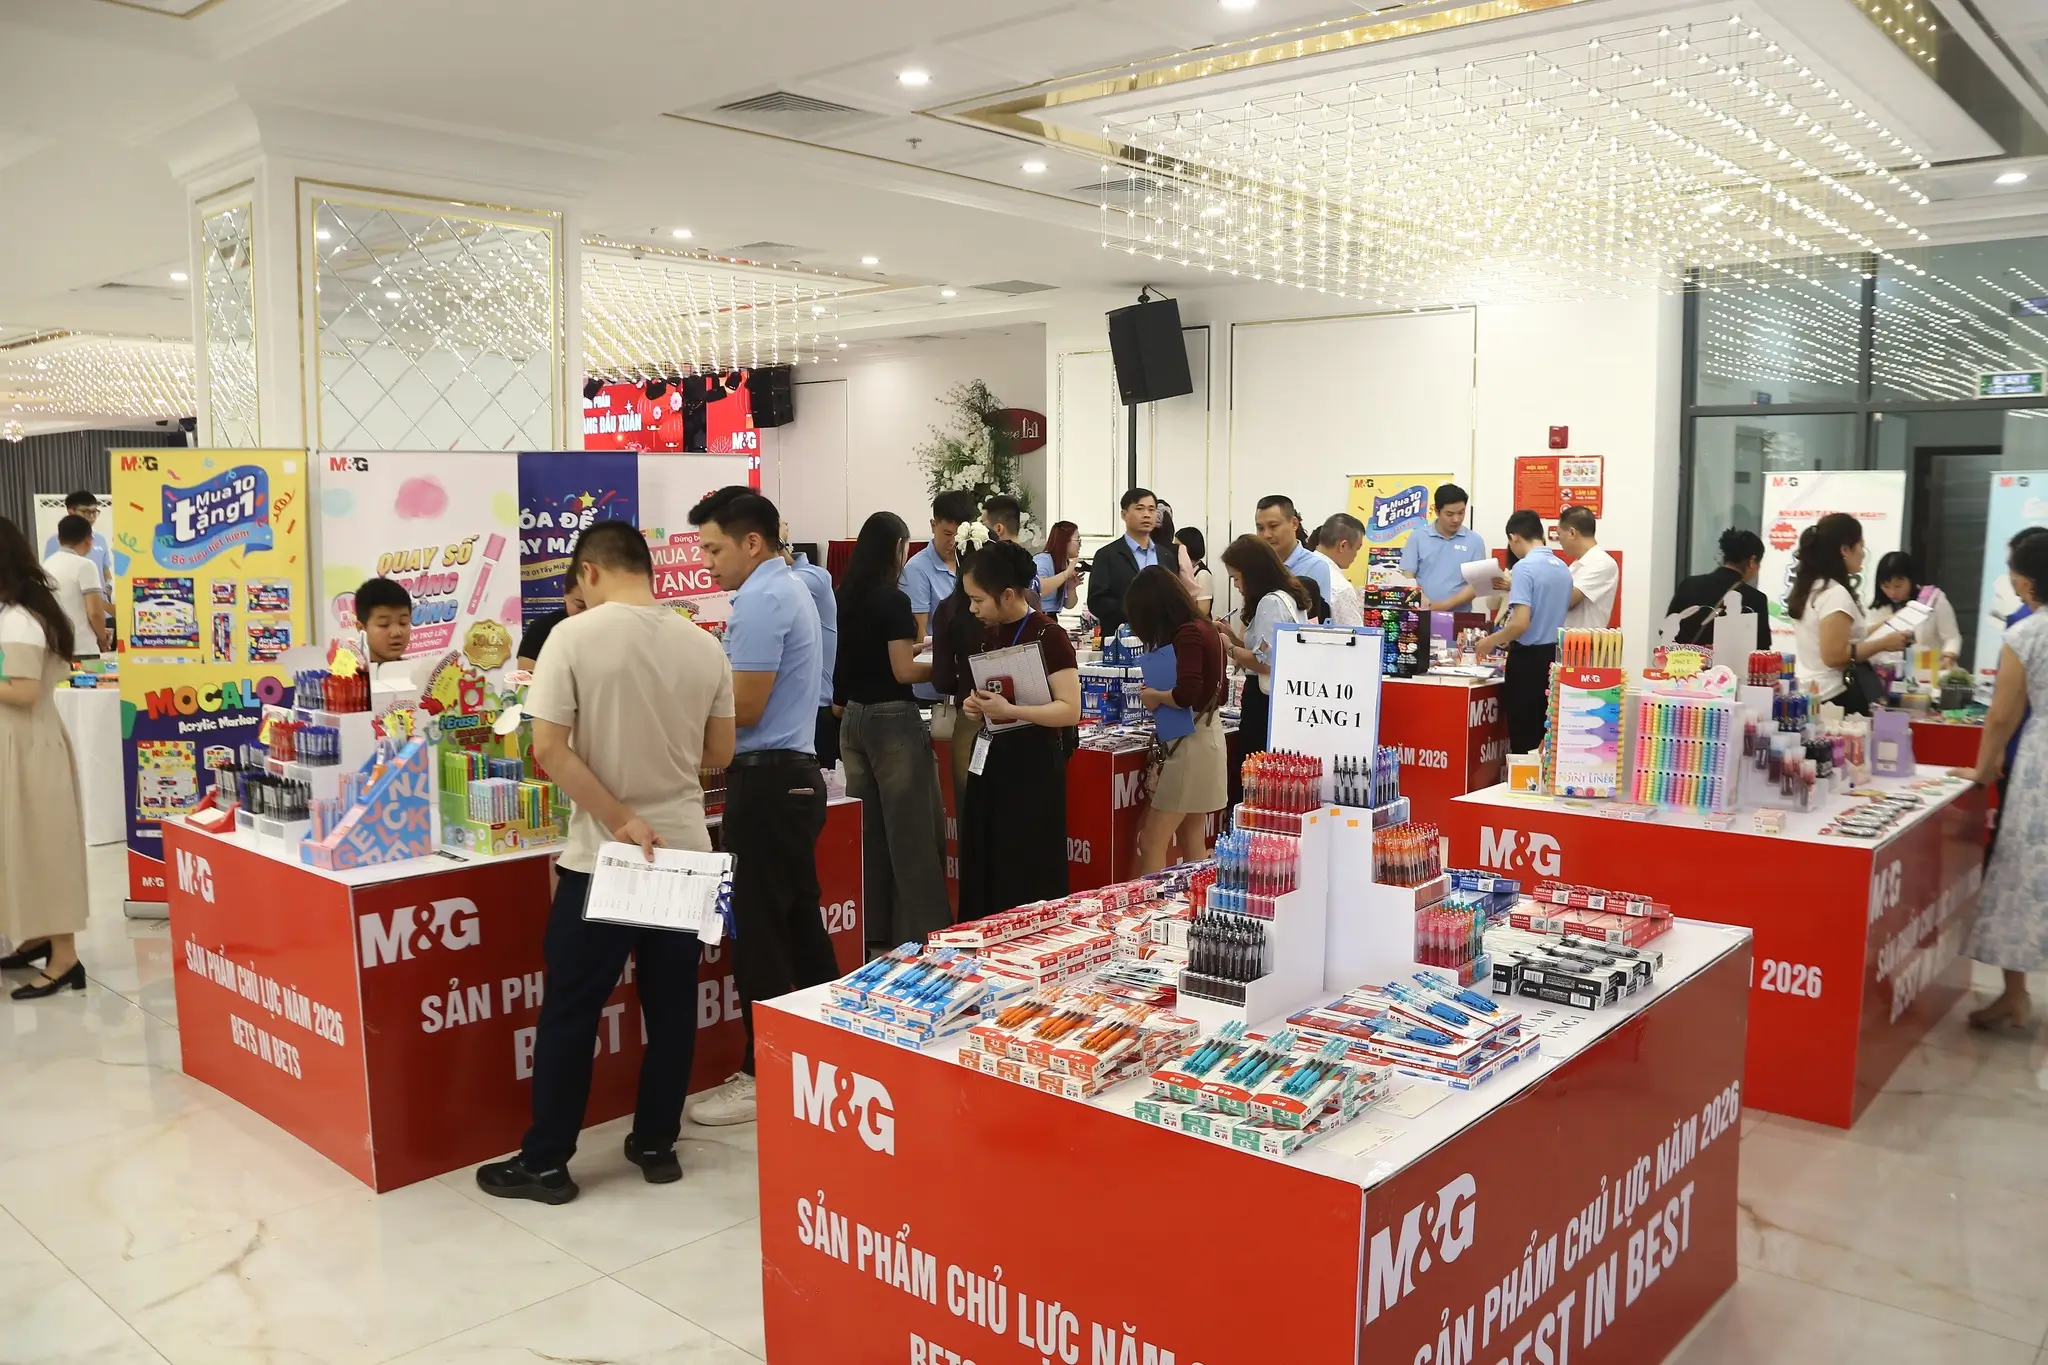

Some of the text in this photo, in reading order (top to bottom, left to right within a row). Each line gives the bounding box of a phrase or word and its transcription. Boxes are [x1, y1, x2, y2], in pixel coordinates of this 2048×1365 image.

[732, 431, 757, 449] M&G
[121, 456, 158, 471] M&G
[330, 457, 368, 471] M&G
[196, 475, 255, 509] Mua 10
[1354, 479, 1374, 488] M&G
[1390, 491, 1421, 509] Mua 10
[377, 534, 480, 577] QUAY SỐ
[520, 538, 542, 556] AY
[1286, 680, 1353, 700] MUA 10
[1581, 674, 1600, 683] M&G
[145, 676, 284, 720] MOCALO
[1470, 697, 1498, 727] M&G
[178, 714, 258, 734] Acrylic Marker
[1295, 706, 1361, 727] TẶNG 1
[1419, 749, 1448, 768] 2026
[1115, 770, 1145, 810] M&
[1588, 776, 1614, 784] LINER
[1067, 837, 1091, 864] 026
[1480, 826, 1561, 876] M&G
[142, 877, 164, 887] M&G
[175, 847, 215, 904] M&G
[359, 896, 481, 969] M&G
[185, 932, 345, 1047] SẢN PHẨM CHỦ LỰC NĂM 2026
[1761, 959, 1822, 998] 2026
[420, 970, 545, 1034] SẢN PH
[230, 1013, 302, 1080] BETS IN BETS
[792, 1052, 895, 1156] M&G
[1482, 1229, 1558, 1349] PHẨM
[1563, 1175, 1609, 1271] CHỦ
[1613, 1155, 1651, 1228] LỰC
[1654, 1118, 1698, 1191] NĂM
[1700, 1079, 1740, 1152] 2026
[1366, 1173, 1476, 1325] M&G
[1583, 1252, 1618, 1349] IN
[1625, 1180, 1695, 1307] BEST
[798, 1189, 849, 1264] SẢN
[857, 1223, 937, 1305] PHẨM
[947, 1265, 1007, 1334] CHỦ
[1018, 1292, 1080, 1365] LỰC
